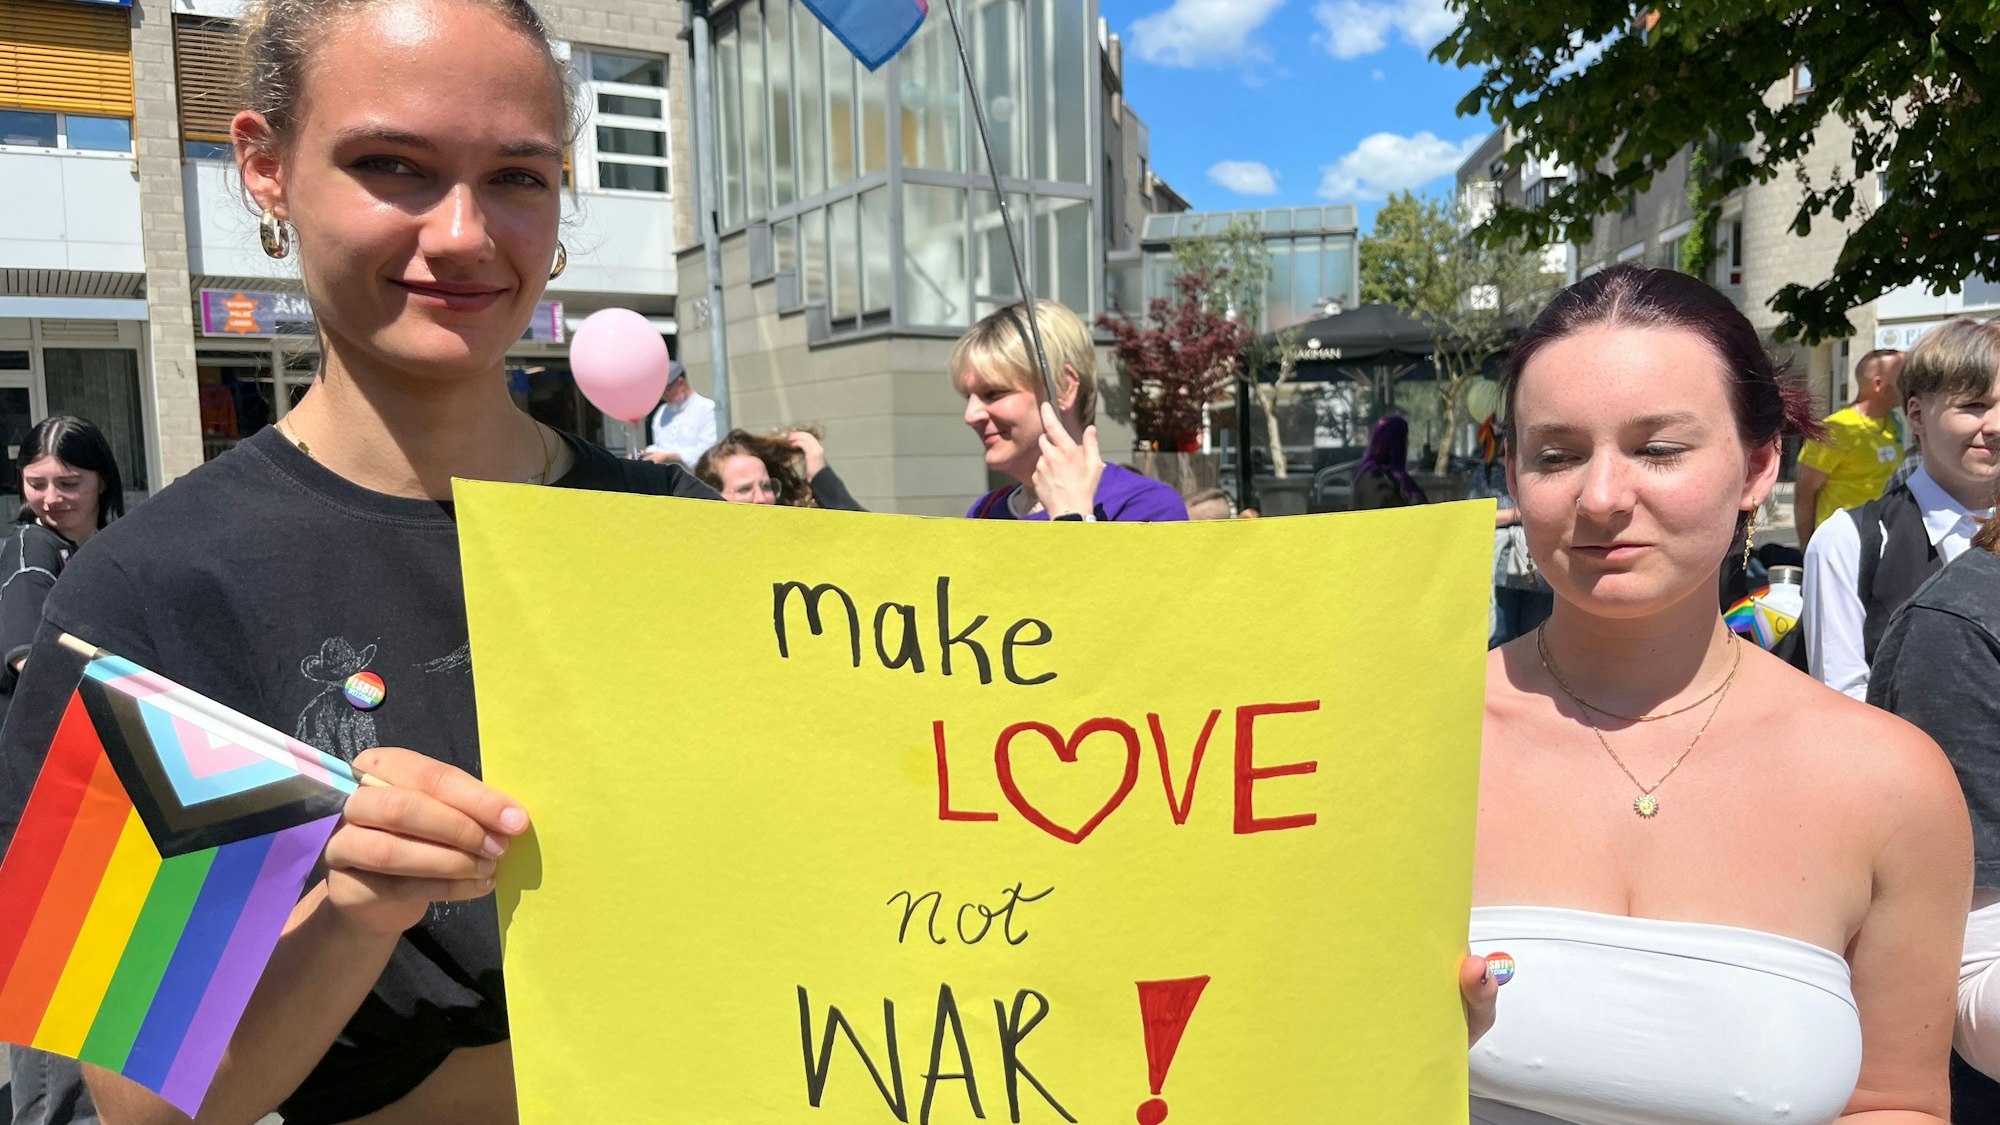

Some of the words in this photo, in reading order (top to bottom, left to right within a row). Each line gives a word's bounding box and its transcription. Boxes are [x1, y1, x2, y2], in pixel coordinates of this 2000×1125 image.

[1294, 347, 1342, 360] AKIMAN
[887, 882, 1055, 946] not
[797, 982, 1078, 1125] WAR
